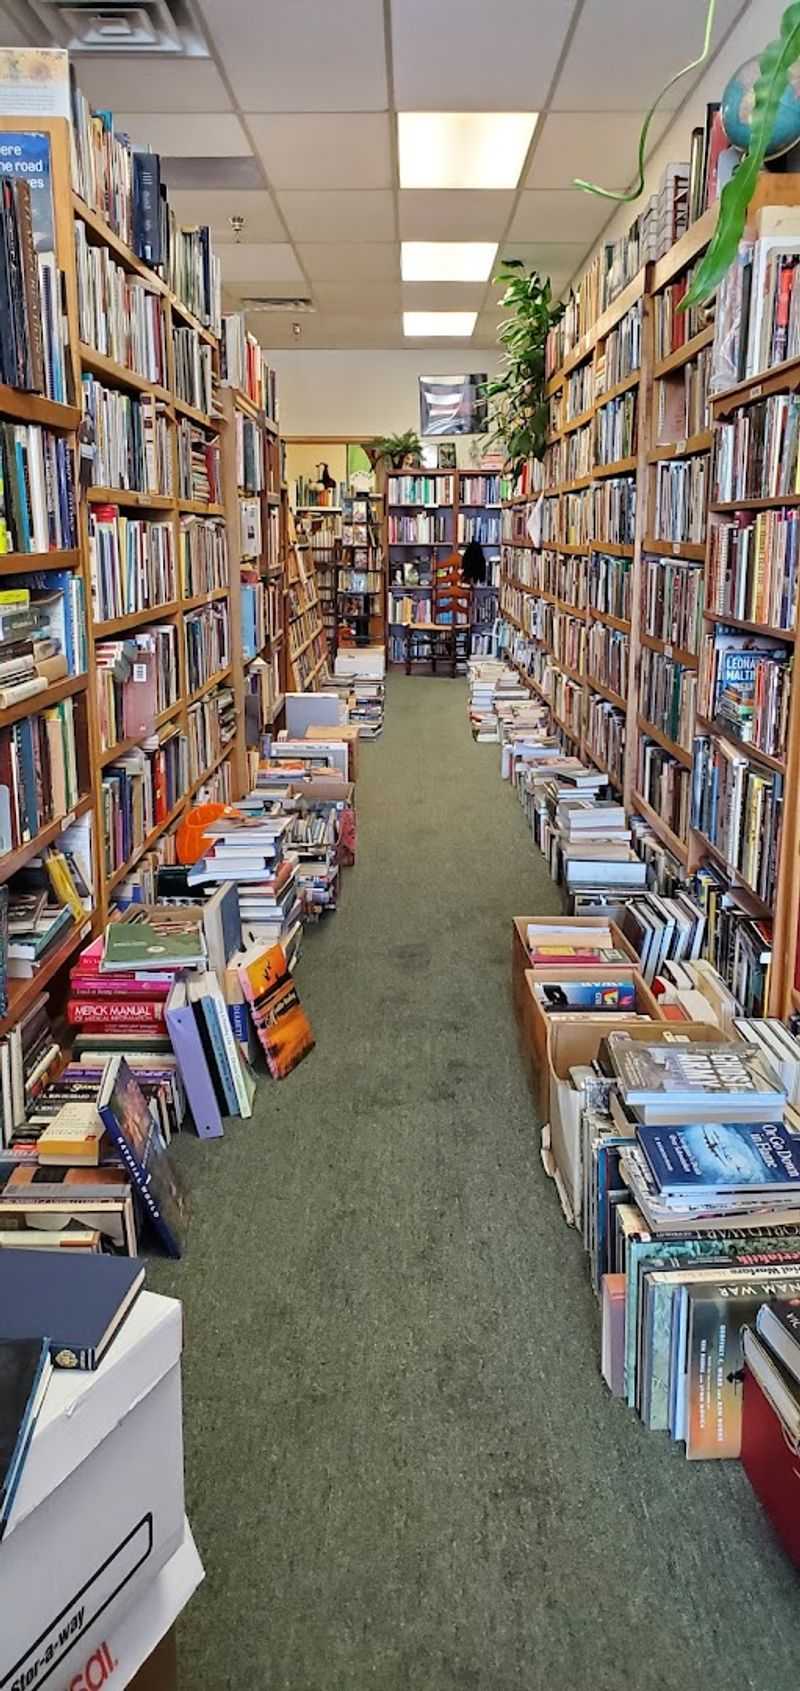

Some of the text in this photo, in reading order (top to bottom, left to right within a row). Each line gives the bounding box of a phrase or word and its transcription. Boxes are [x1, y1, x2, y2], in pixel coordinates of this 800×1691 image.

[15, 160, 43, 172] road
[727, 656, 755, 669] LEONA
[75, 1005, 151, 1016] MERCK MANUAL
[777, 1149, 800, 1177] Down
[117, 1137, 160, 1218] MATERIAL WORLD
[705, 1226, 746, 1239] WAR
[730, 1266, 780, 1276] Warfare
[718, 1286, 756, 1297] WAR
[11, 1605, 85, 1691] Stor-a-way
